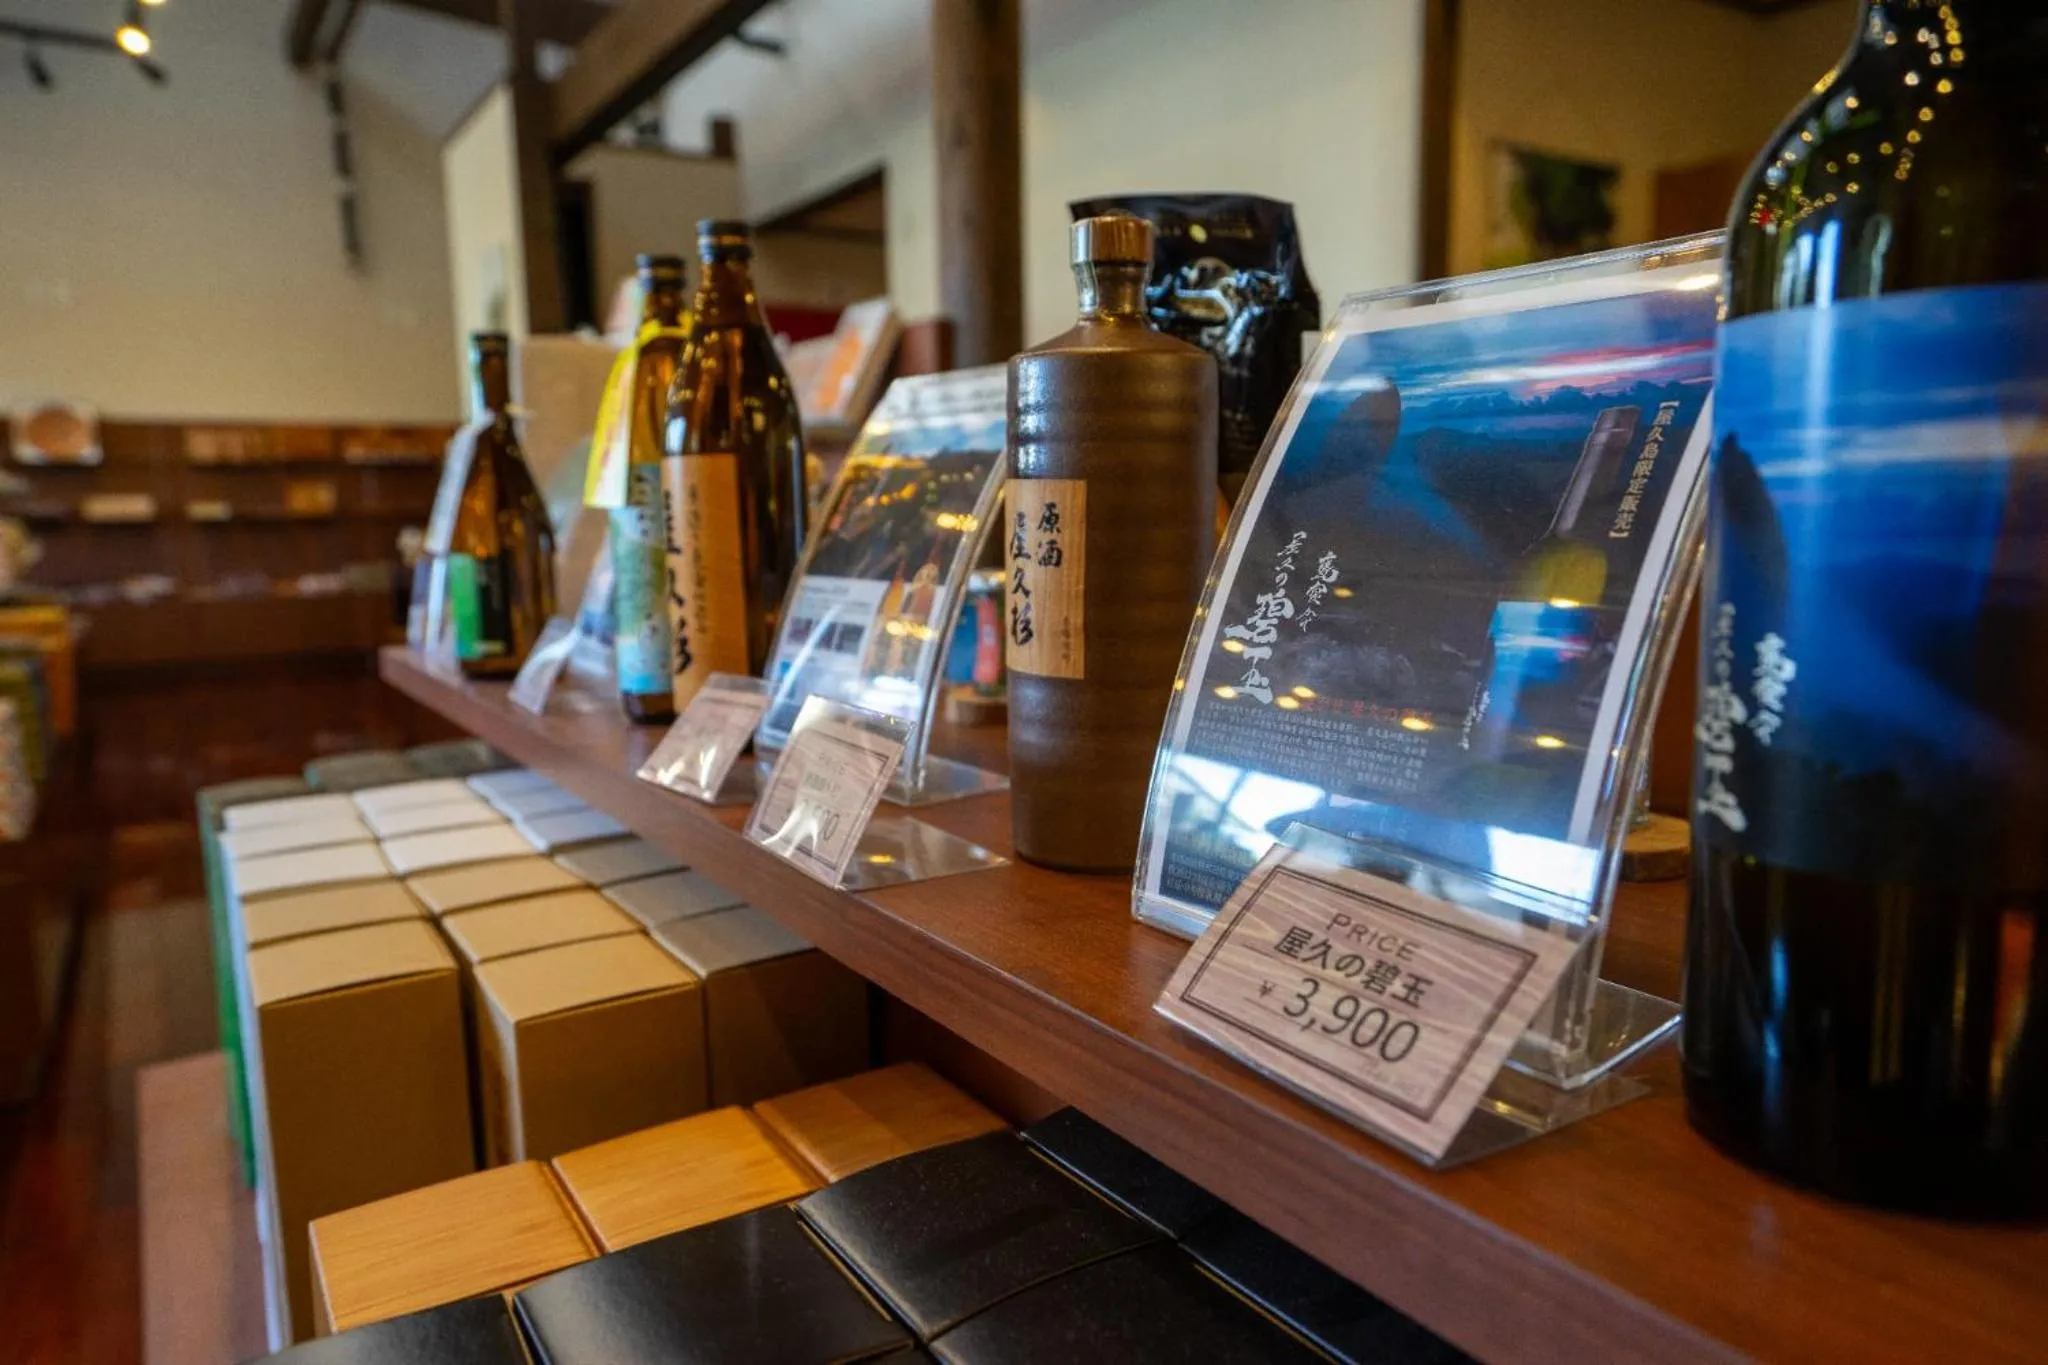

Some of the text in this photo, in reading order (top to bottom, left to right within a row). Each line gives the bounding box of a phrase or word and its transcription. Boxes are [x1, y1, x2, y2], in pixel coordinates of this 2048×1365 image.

[1037, 502, 1063, 568] 原酒
[1010, 511, 1034, 646] 屋久杉
[1273, 925, 1434, 1009] 屋久の碧玉
[1326, 912, 1418, 961] PRICE
[1281, 977, 1421, 1064] 3,900
